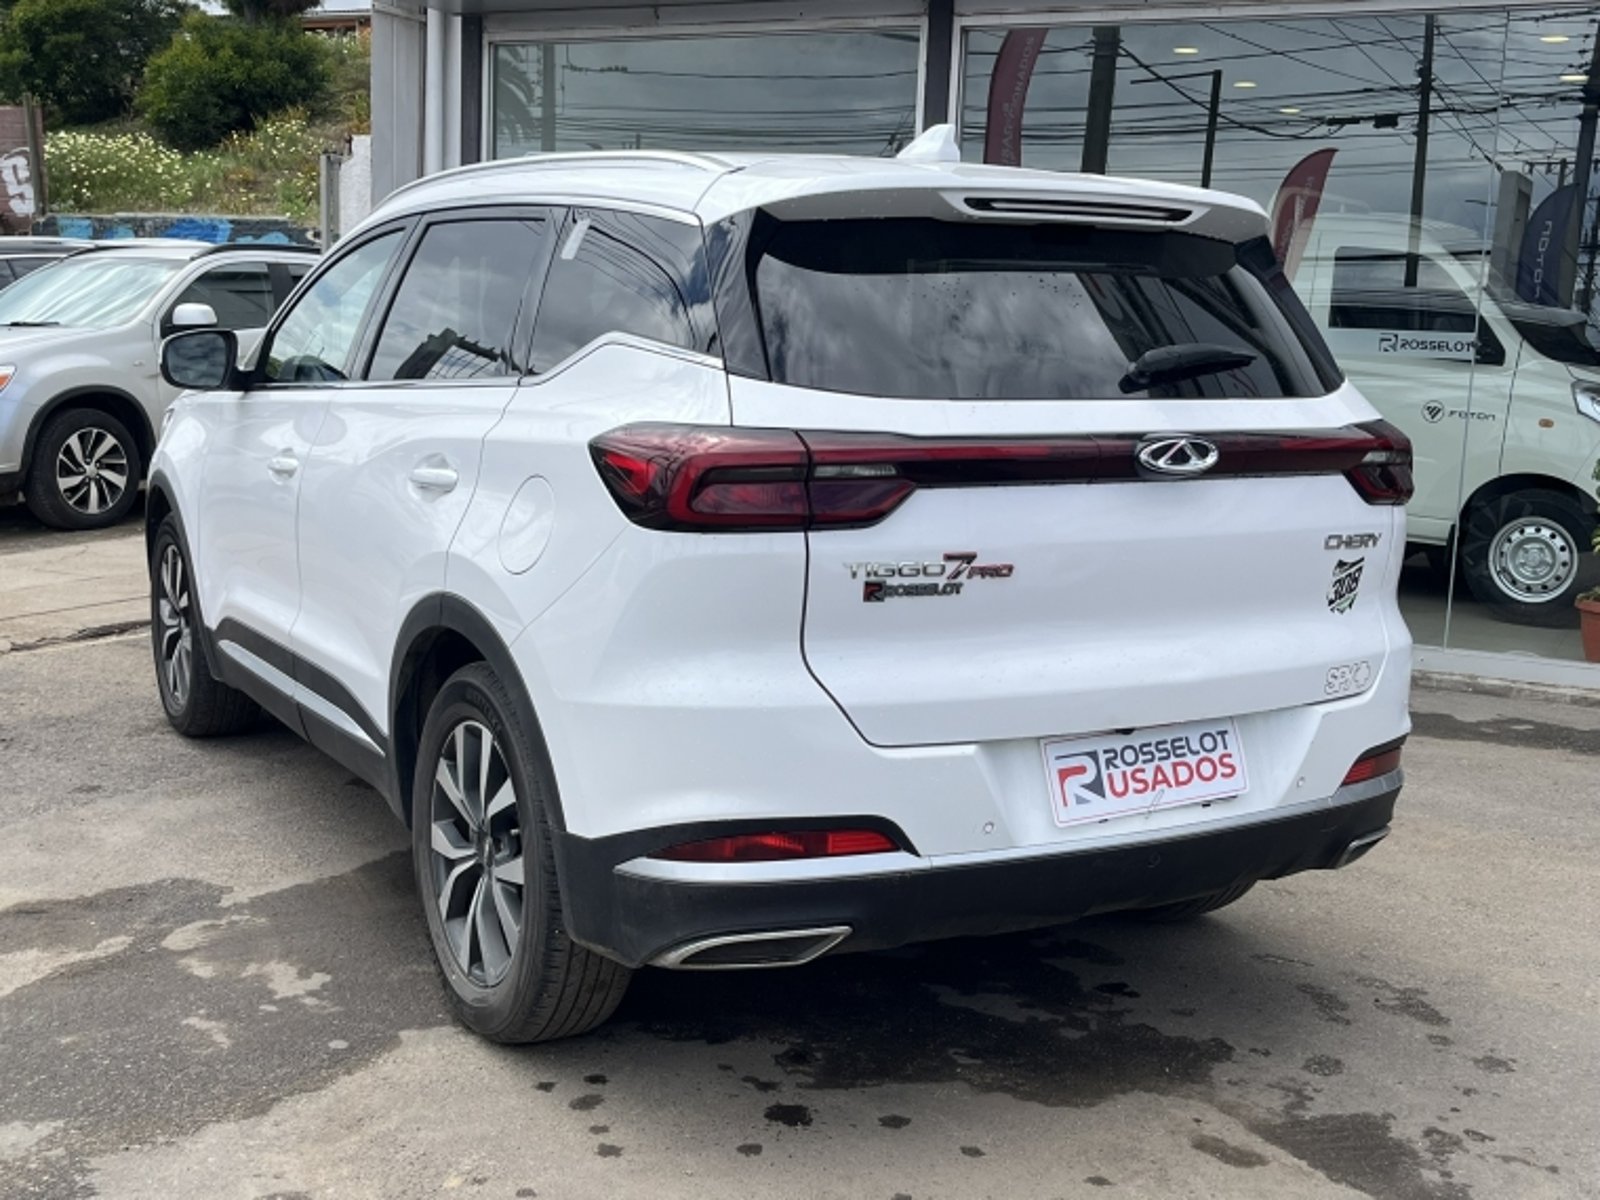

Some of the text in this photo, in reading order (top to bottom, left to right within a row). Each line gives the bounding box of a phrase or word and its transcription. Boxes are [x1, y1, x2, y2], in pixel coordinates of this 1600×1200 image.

[1400, 338, 1474, 353] ROSSELOT
[1448, 409, 1496, 421] FOTON
[1324, 532, 1382, 550] CHERY
[843, 552, 1015, 580] TIGGO 7 PRO
[884, 581, 964, 598] ROSSELOT
[1102, 729, 1229, 771] ROSSELOT
[1106, 752, 1237, 799] USADOS
